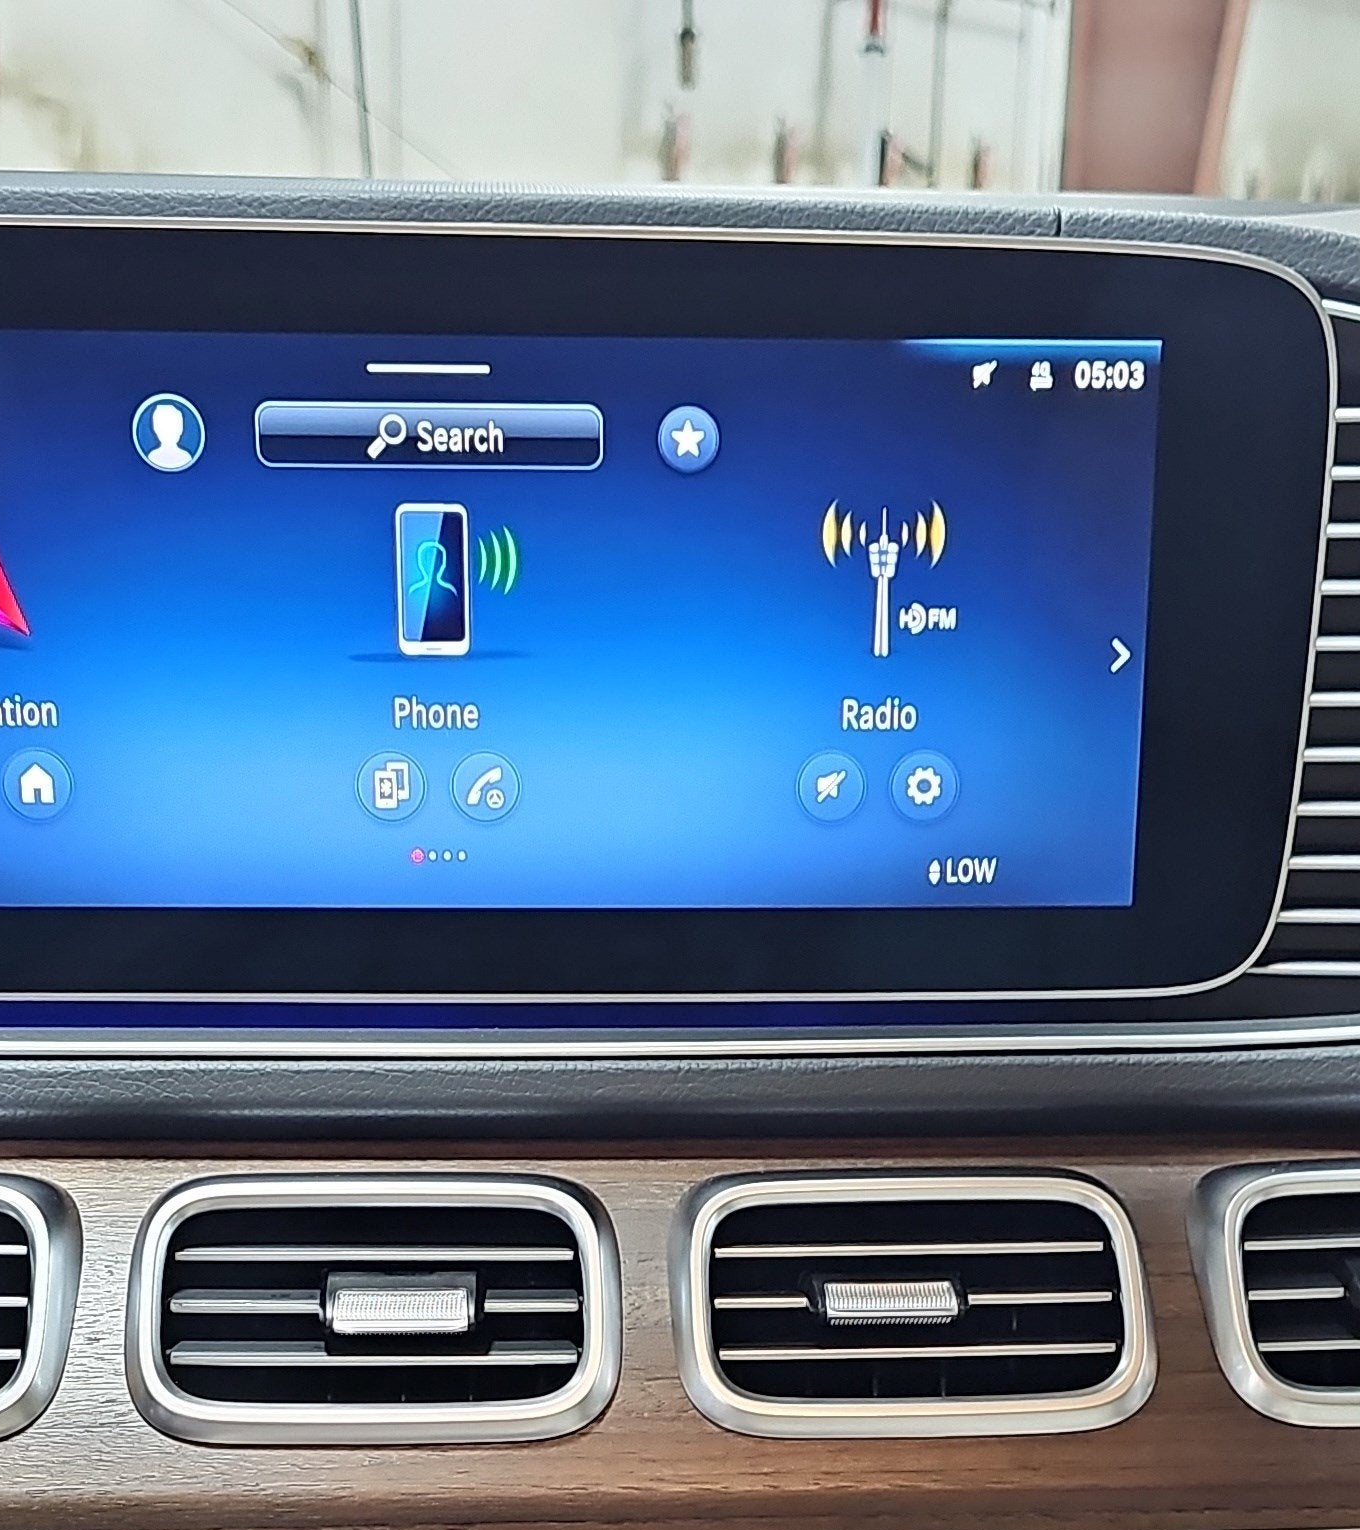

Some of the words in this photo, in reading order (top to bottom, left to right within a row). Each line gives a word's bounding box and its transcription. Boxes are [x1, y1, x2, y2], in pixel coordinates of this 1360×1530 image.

[1074, 360, 1145, 389] 05:03
[416, 420, 504, 454] Search
[393, 697, 480, 730] Phone
[842, 697, 917, 731] Radio
[945, 858, 997, 884] LOW
